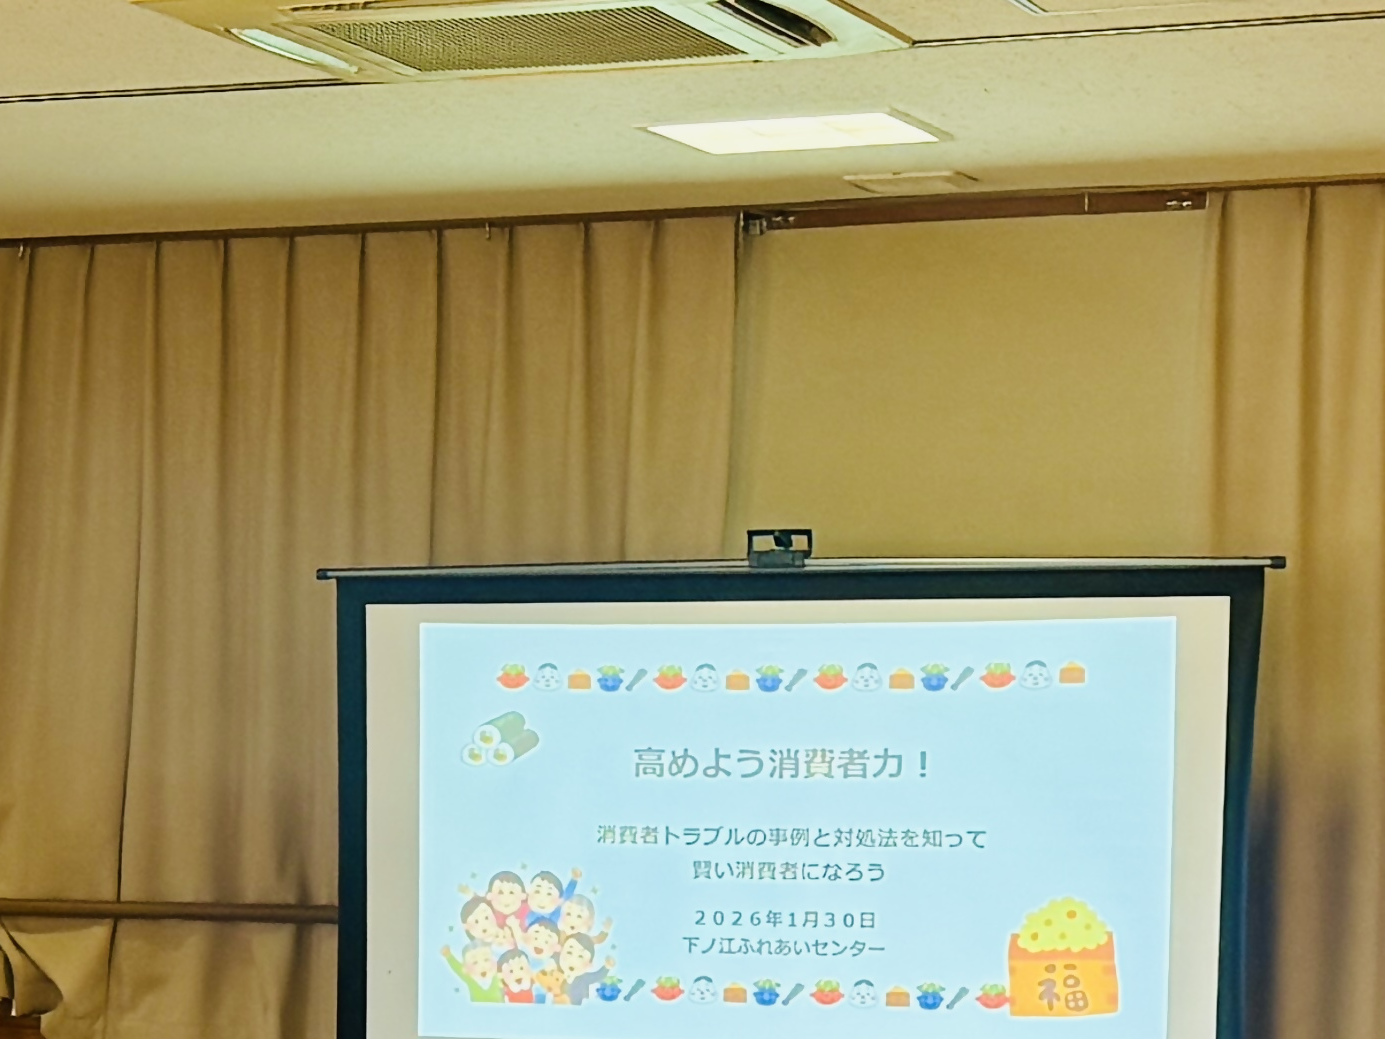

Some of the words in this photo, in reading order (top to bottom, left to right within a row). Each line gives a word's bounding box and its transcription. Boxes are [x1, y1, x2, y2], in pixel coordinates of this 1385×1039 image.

[597, 825, 987, 850] 消費者トラブルの事例と対処法を知って
[692, 860, 886, 882] 賢い消費者になろう
[682, 936, 886, 958] 下ノ江ふれあいセンター
[1037, 963, 1089, 1012] 福
